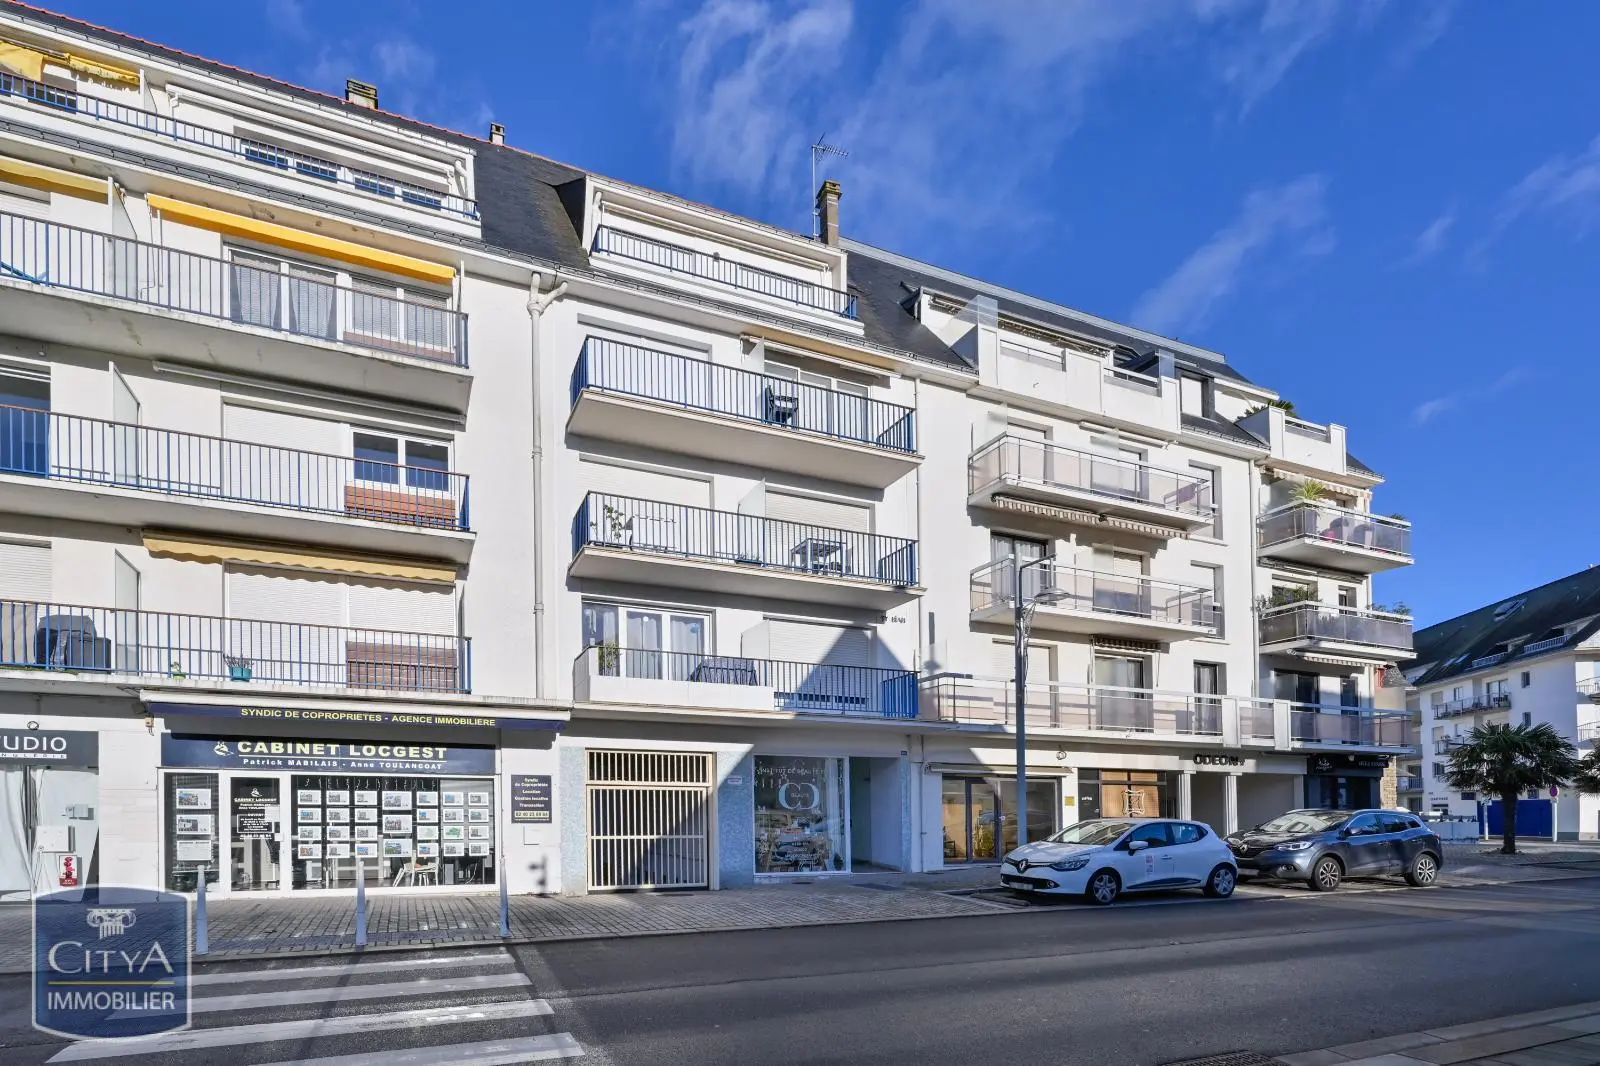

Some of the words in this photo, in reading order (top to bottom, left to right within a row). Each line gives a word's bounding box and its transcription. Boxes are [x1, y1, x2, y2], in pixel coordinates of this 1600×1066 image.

[241, 708, 281, 717] SYNDIC
[284, 710, 299, 718] DE
[302, 711, 382, 722] COPROPRIETES
[391, 715, 433, 724] AGENCE
[435, 717, 496, 726] IMMOBILIERE
[0, 736, 67, 752] UDIO
[237, 741, 340, 755] CABINET
[349, 745, 447, 759] LOCGEST
